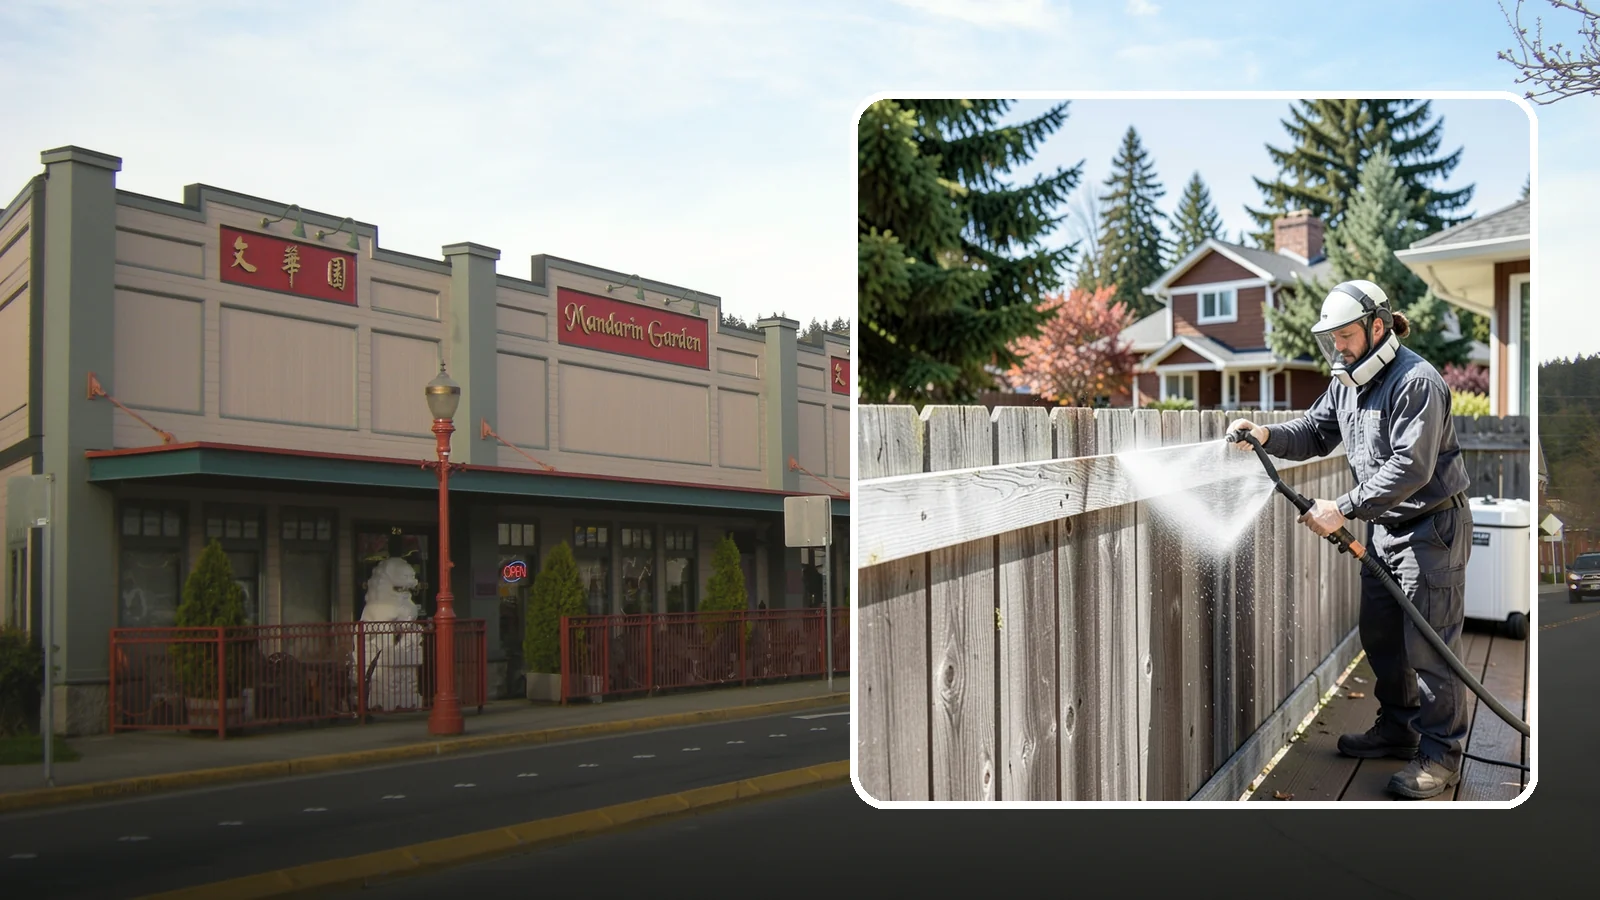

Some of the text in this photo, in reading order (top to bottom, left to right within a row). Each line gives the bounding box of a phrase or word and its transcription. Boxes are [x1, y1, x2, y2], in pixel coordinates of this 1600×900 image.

[231, 236, 346, 290] 文華園
[565, 302, 702, 352] Mandarin Garden
[503, 565, 527, 578] OPEN
